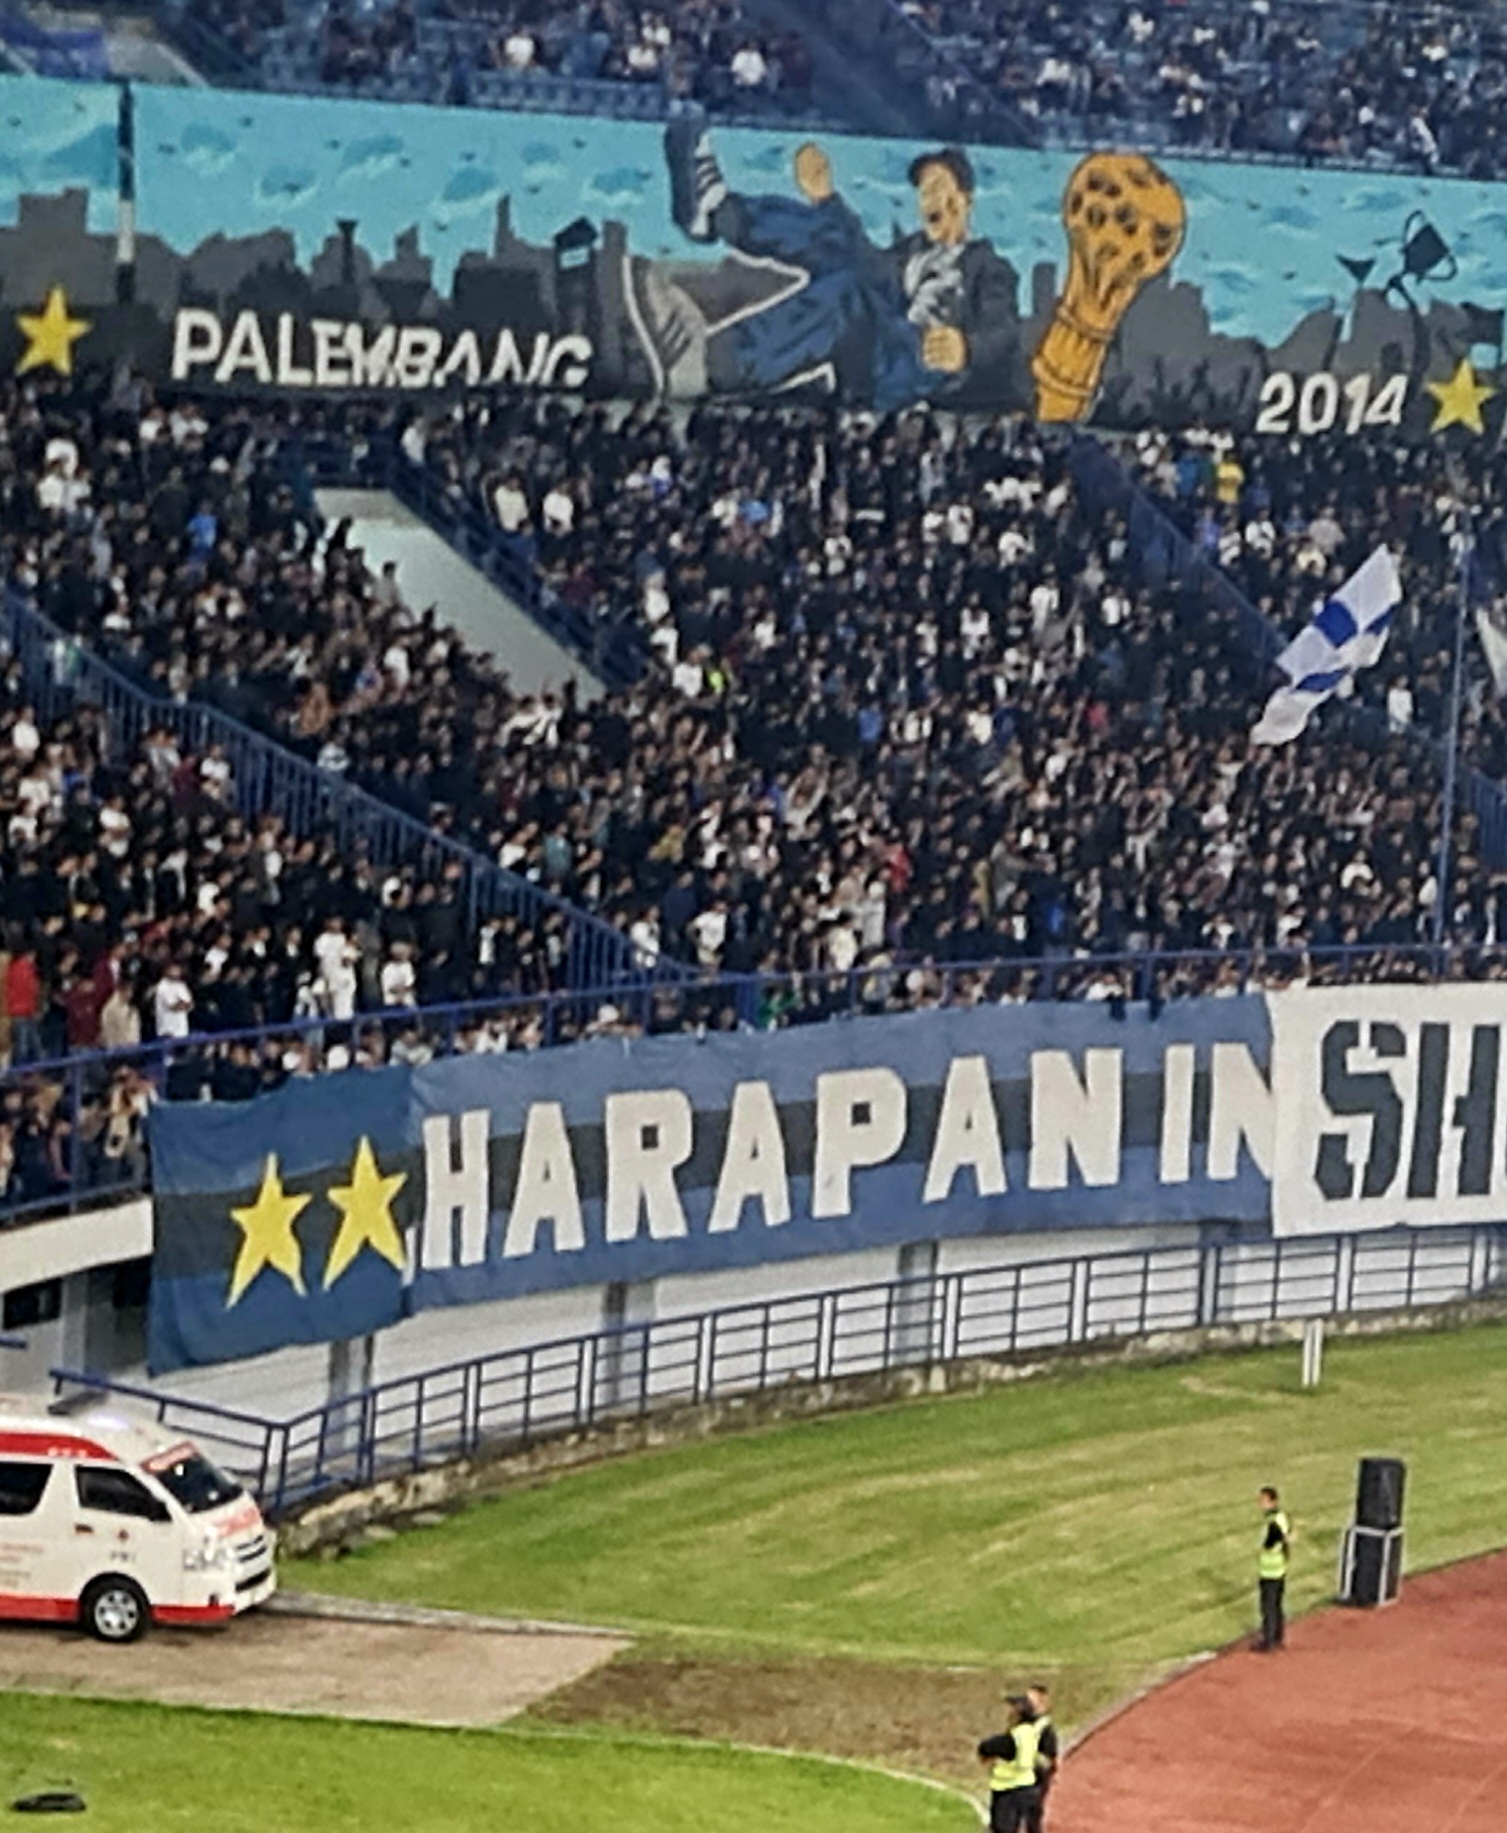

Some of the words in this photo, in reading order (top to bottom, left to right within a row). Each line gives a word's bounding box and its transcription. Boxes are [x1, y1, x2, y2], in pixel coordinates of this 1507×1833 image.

[170, 308, 594, 389] PALEMBANG
[1255, 371, 1408, 434] 2014
[421, 1046, 1124, 1270] HARAPAN
